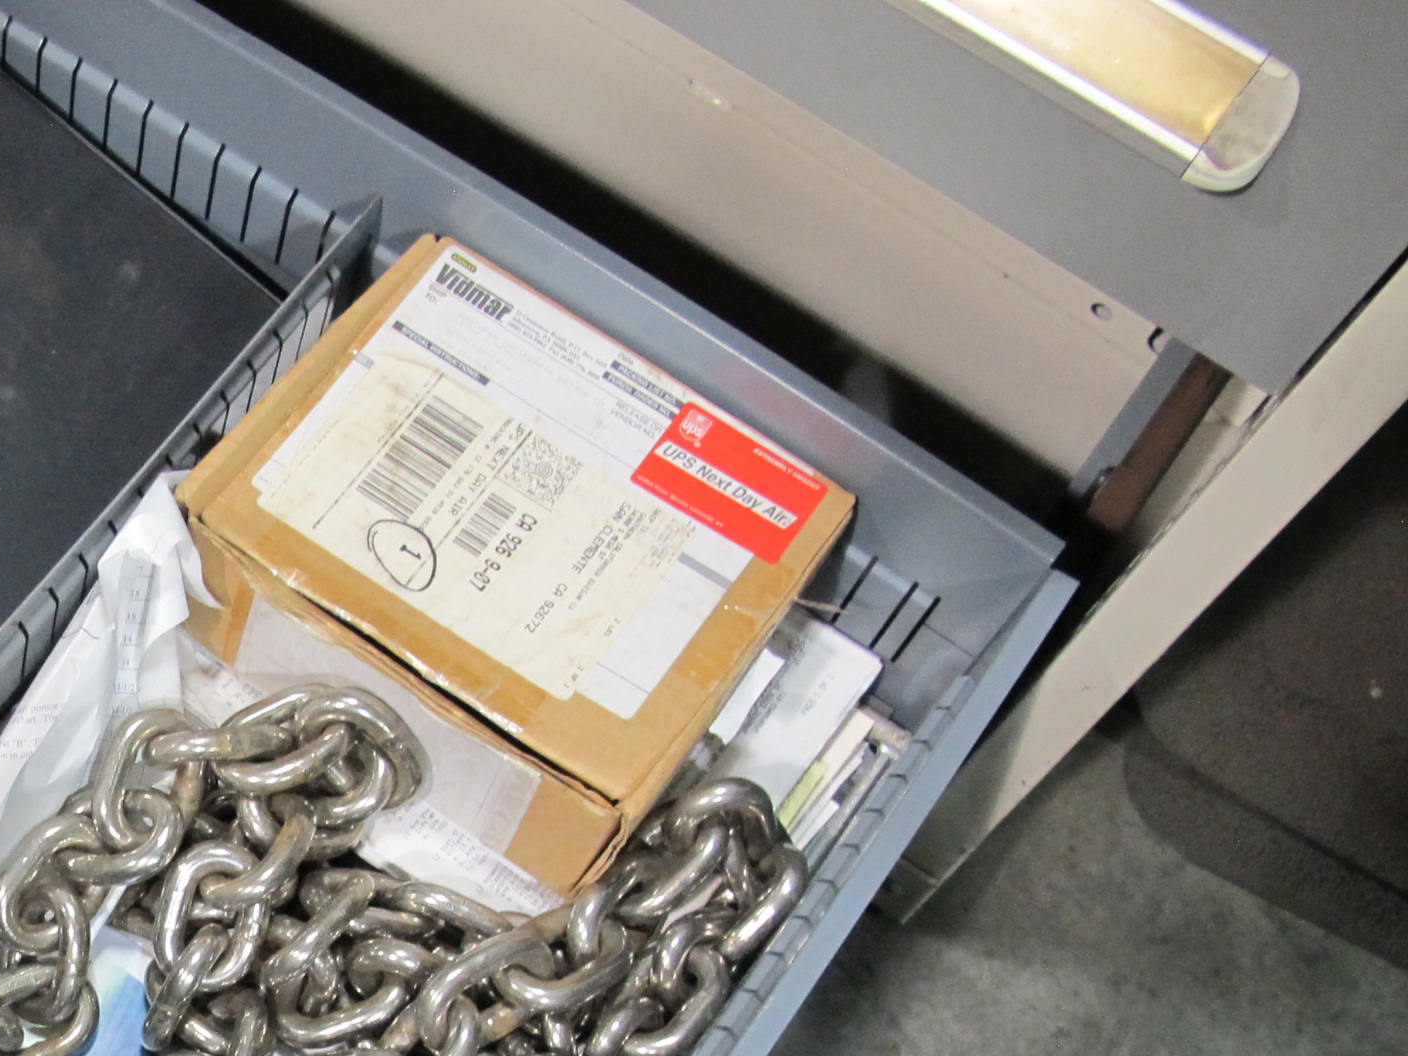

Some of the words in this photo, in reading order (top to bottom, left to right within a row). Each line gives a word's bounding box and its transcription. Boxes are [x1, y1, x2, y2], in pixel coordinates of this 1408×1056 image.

[434, 262, 513, 324] Vidmar
[679, 417, 705, 441] ups
[485, 443, 510, 470] NEXT
[466, 472, 487, 493] DAY
[661, 442, 697, 471] UPS
[694, 462, 734, 493] Next
[730, 483, 764, 513] Day
[447, 495, 468, 517] AIR
[610, 501, 632, 522] SAN
[513, 512, 539, 533] CA
[399, 543, 423, 561] 1
[492, 531, 523, 558] 926
[569, 523, 615, 575] CLEMENTE
[466, 557, 503, 593] 9-07
[551, 581, 569, 598] CA
[523, 598, 555, 634] 92672
